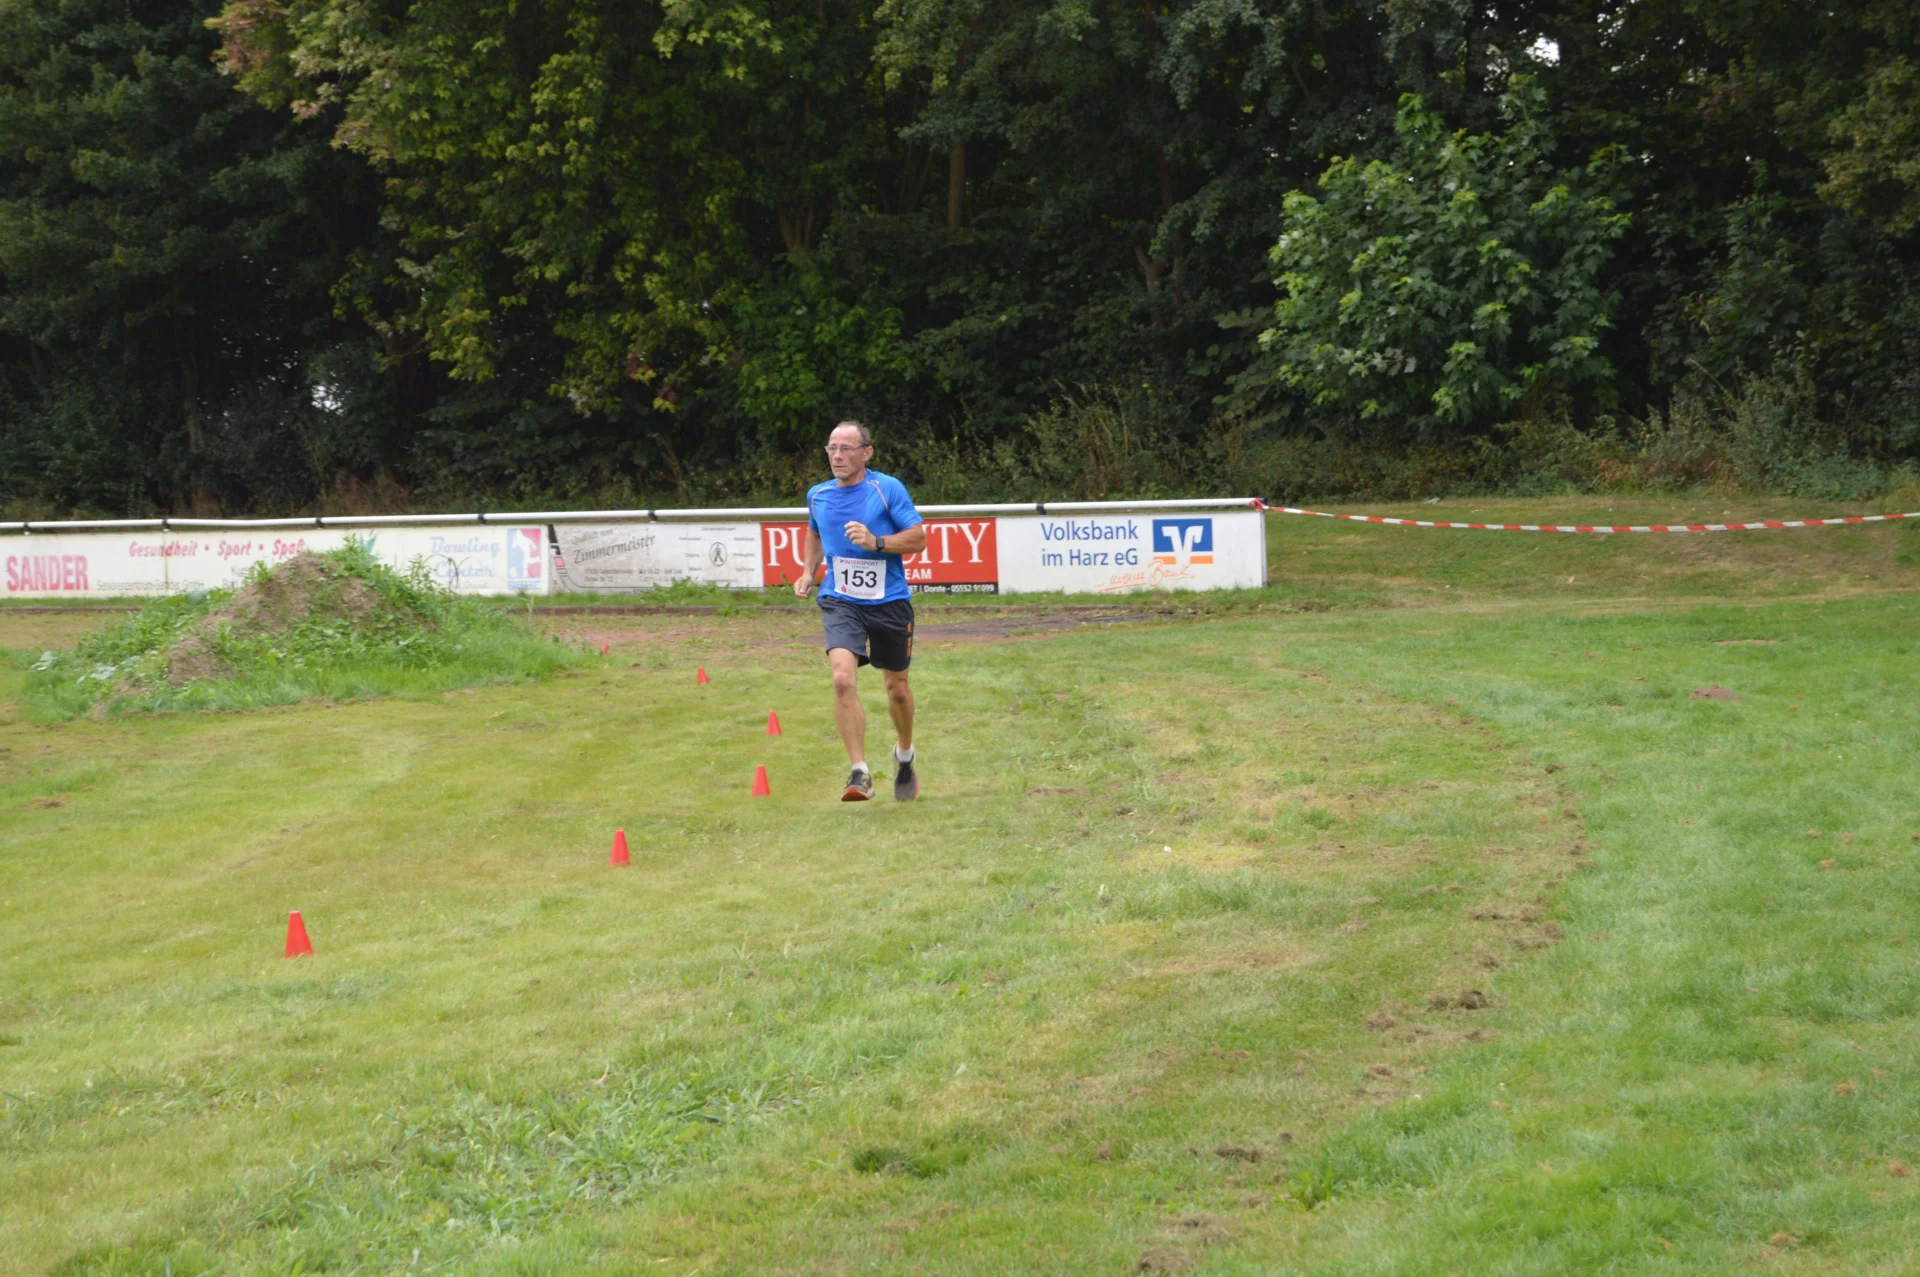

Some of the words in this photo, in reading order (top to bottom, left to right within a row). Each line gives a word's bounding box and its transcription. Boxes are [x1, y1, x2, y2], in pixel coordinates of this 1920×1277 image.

[1040, 520, 1139, 541] Volksbank
[129, 540, 198, 557] Gesundheit
[217, 539, 252, 560] Sport
[430, 536, 500, 557] Bowling
[574, 535, 656, 564] Zimmermeister
[765, 522, 990, 567] PUITY
[843, 559, 878, 567] INTERSPORT
[1042, 549, 1063, 566] im
[1069, 548, 1109, 566] Harz
[1114, 547, 1139, 566] eG
[6, 555, 89, 592] SANDER
[433, 560, 496, 577] Center
[841, 569, 877, 588] 153
[904, 568, 932, 580] EAM
